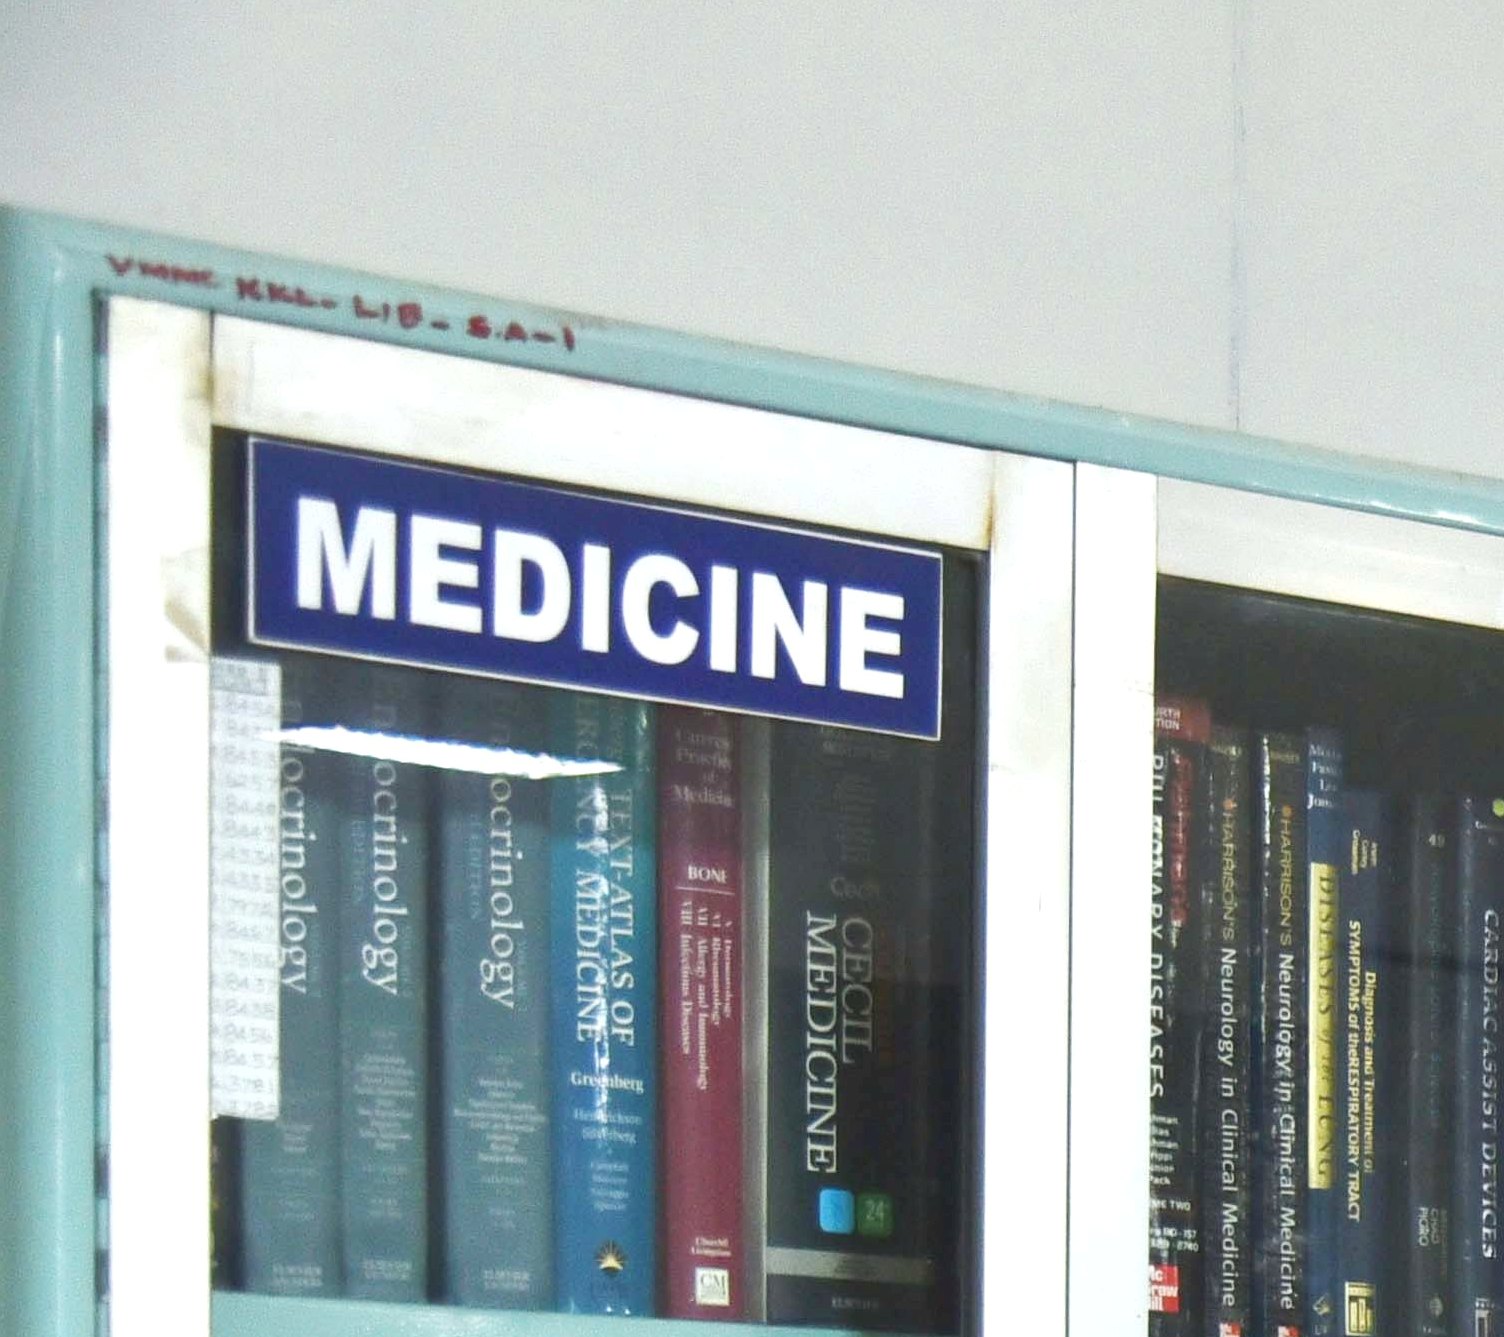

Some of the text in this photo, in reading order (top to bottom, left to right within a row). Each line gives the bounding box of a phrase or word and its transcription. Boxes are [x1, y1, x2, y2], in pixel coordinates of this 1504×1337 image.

[294, 494, 906, 700] MEDICINE
[805, 910, 837, 1175] MEDICINE
[842, 916, 873, 1064] CECIL
[1219, 811, 1239, 1308] HARRISON'S Neurology in Clinical Medicine
[1482, 911, 1499, 1260] CARDIAC ASSIST DEVICES
